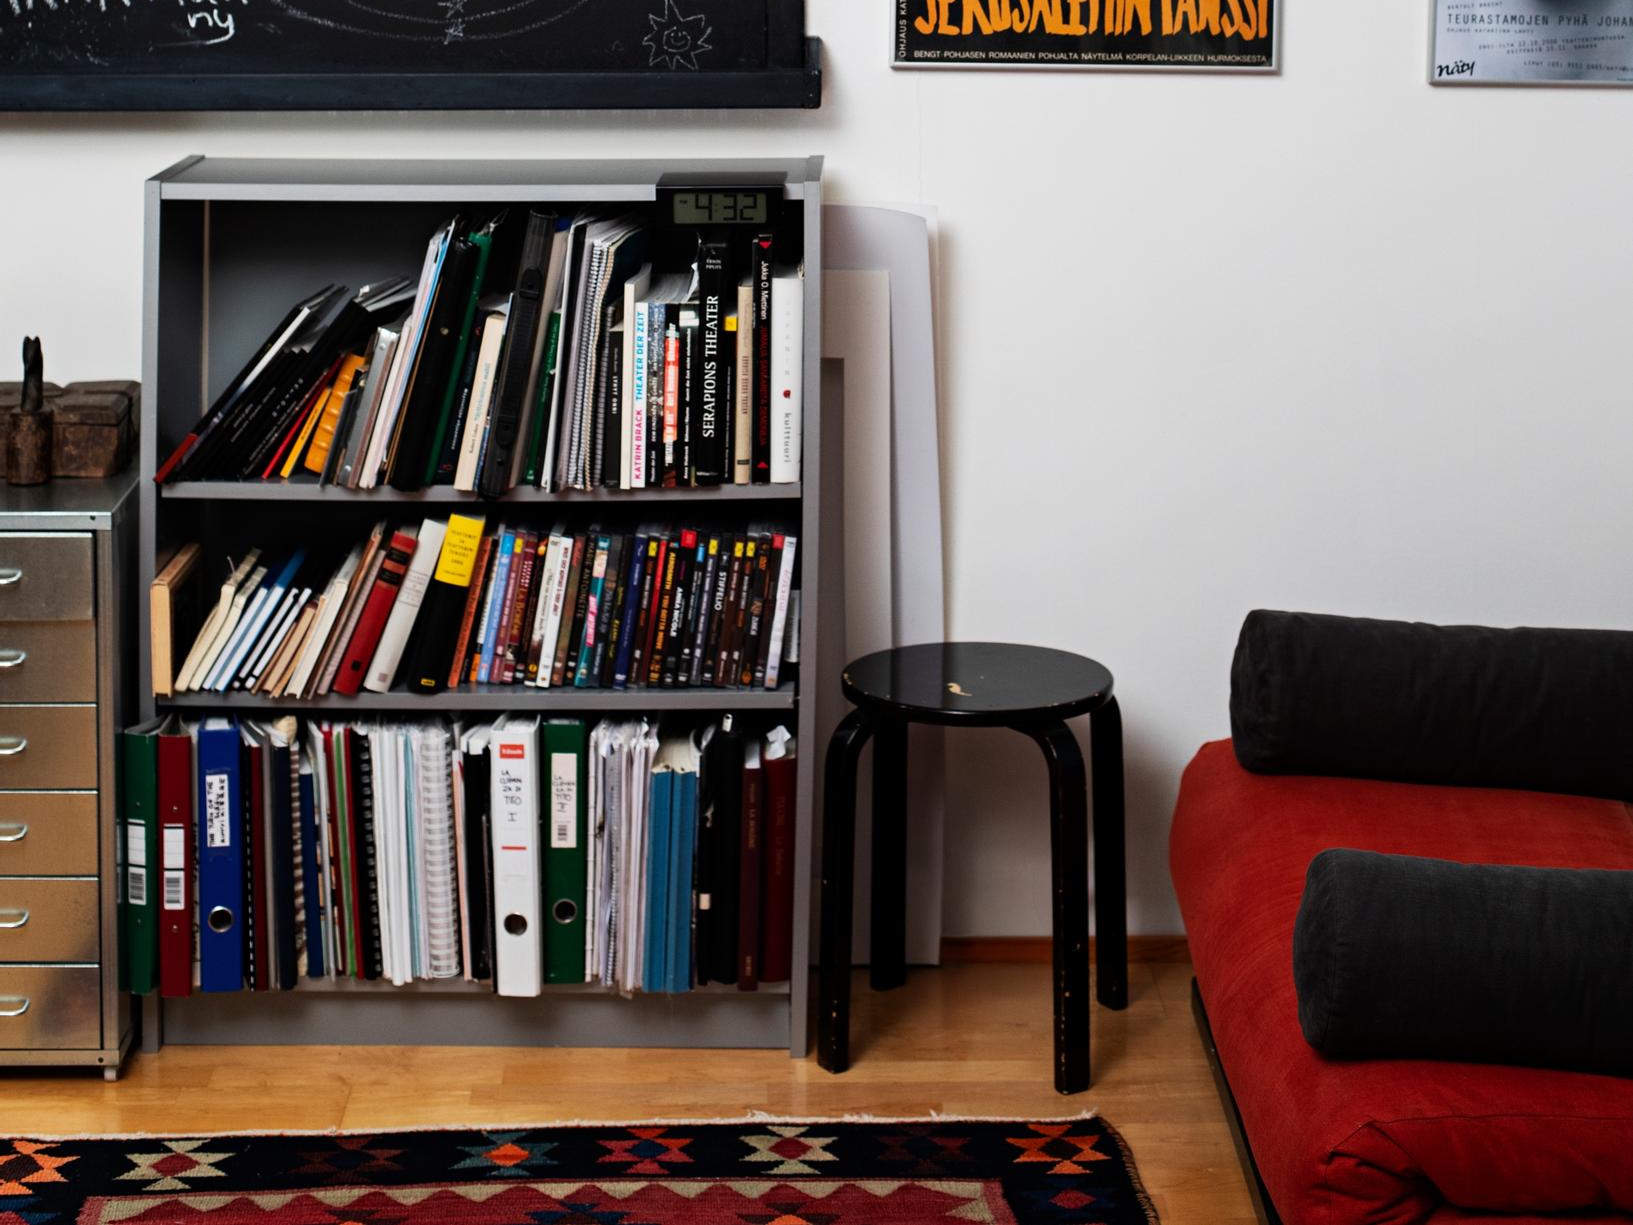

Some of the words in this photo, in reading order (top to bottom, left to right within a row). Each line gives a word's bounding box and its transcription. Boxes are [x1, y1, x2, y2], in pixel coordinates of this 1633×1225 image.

[1448, 14, 1549, 26] TEURASTAMOJEN
[1558, 14, 1588, 26] PYHÄ
[899, 19, 907, 58] OHJAUS
[914, 50, 940, 58] BENGT
[635, 311, 646, 334] ZEIT
[704, 295, 718, 357] THEATER
[635, 336, 645, 355] DER
[635, 357, 645, 401] THEATER
[703, 361, 717, 438] SERAPIONS
[634, 409, 644, 442] BRACK
[633, 444, 644, 480] KATRIN
[713, 571, 726, 610] STIFFELIO
